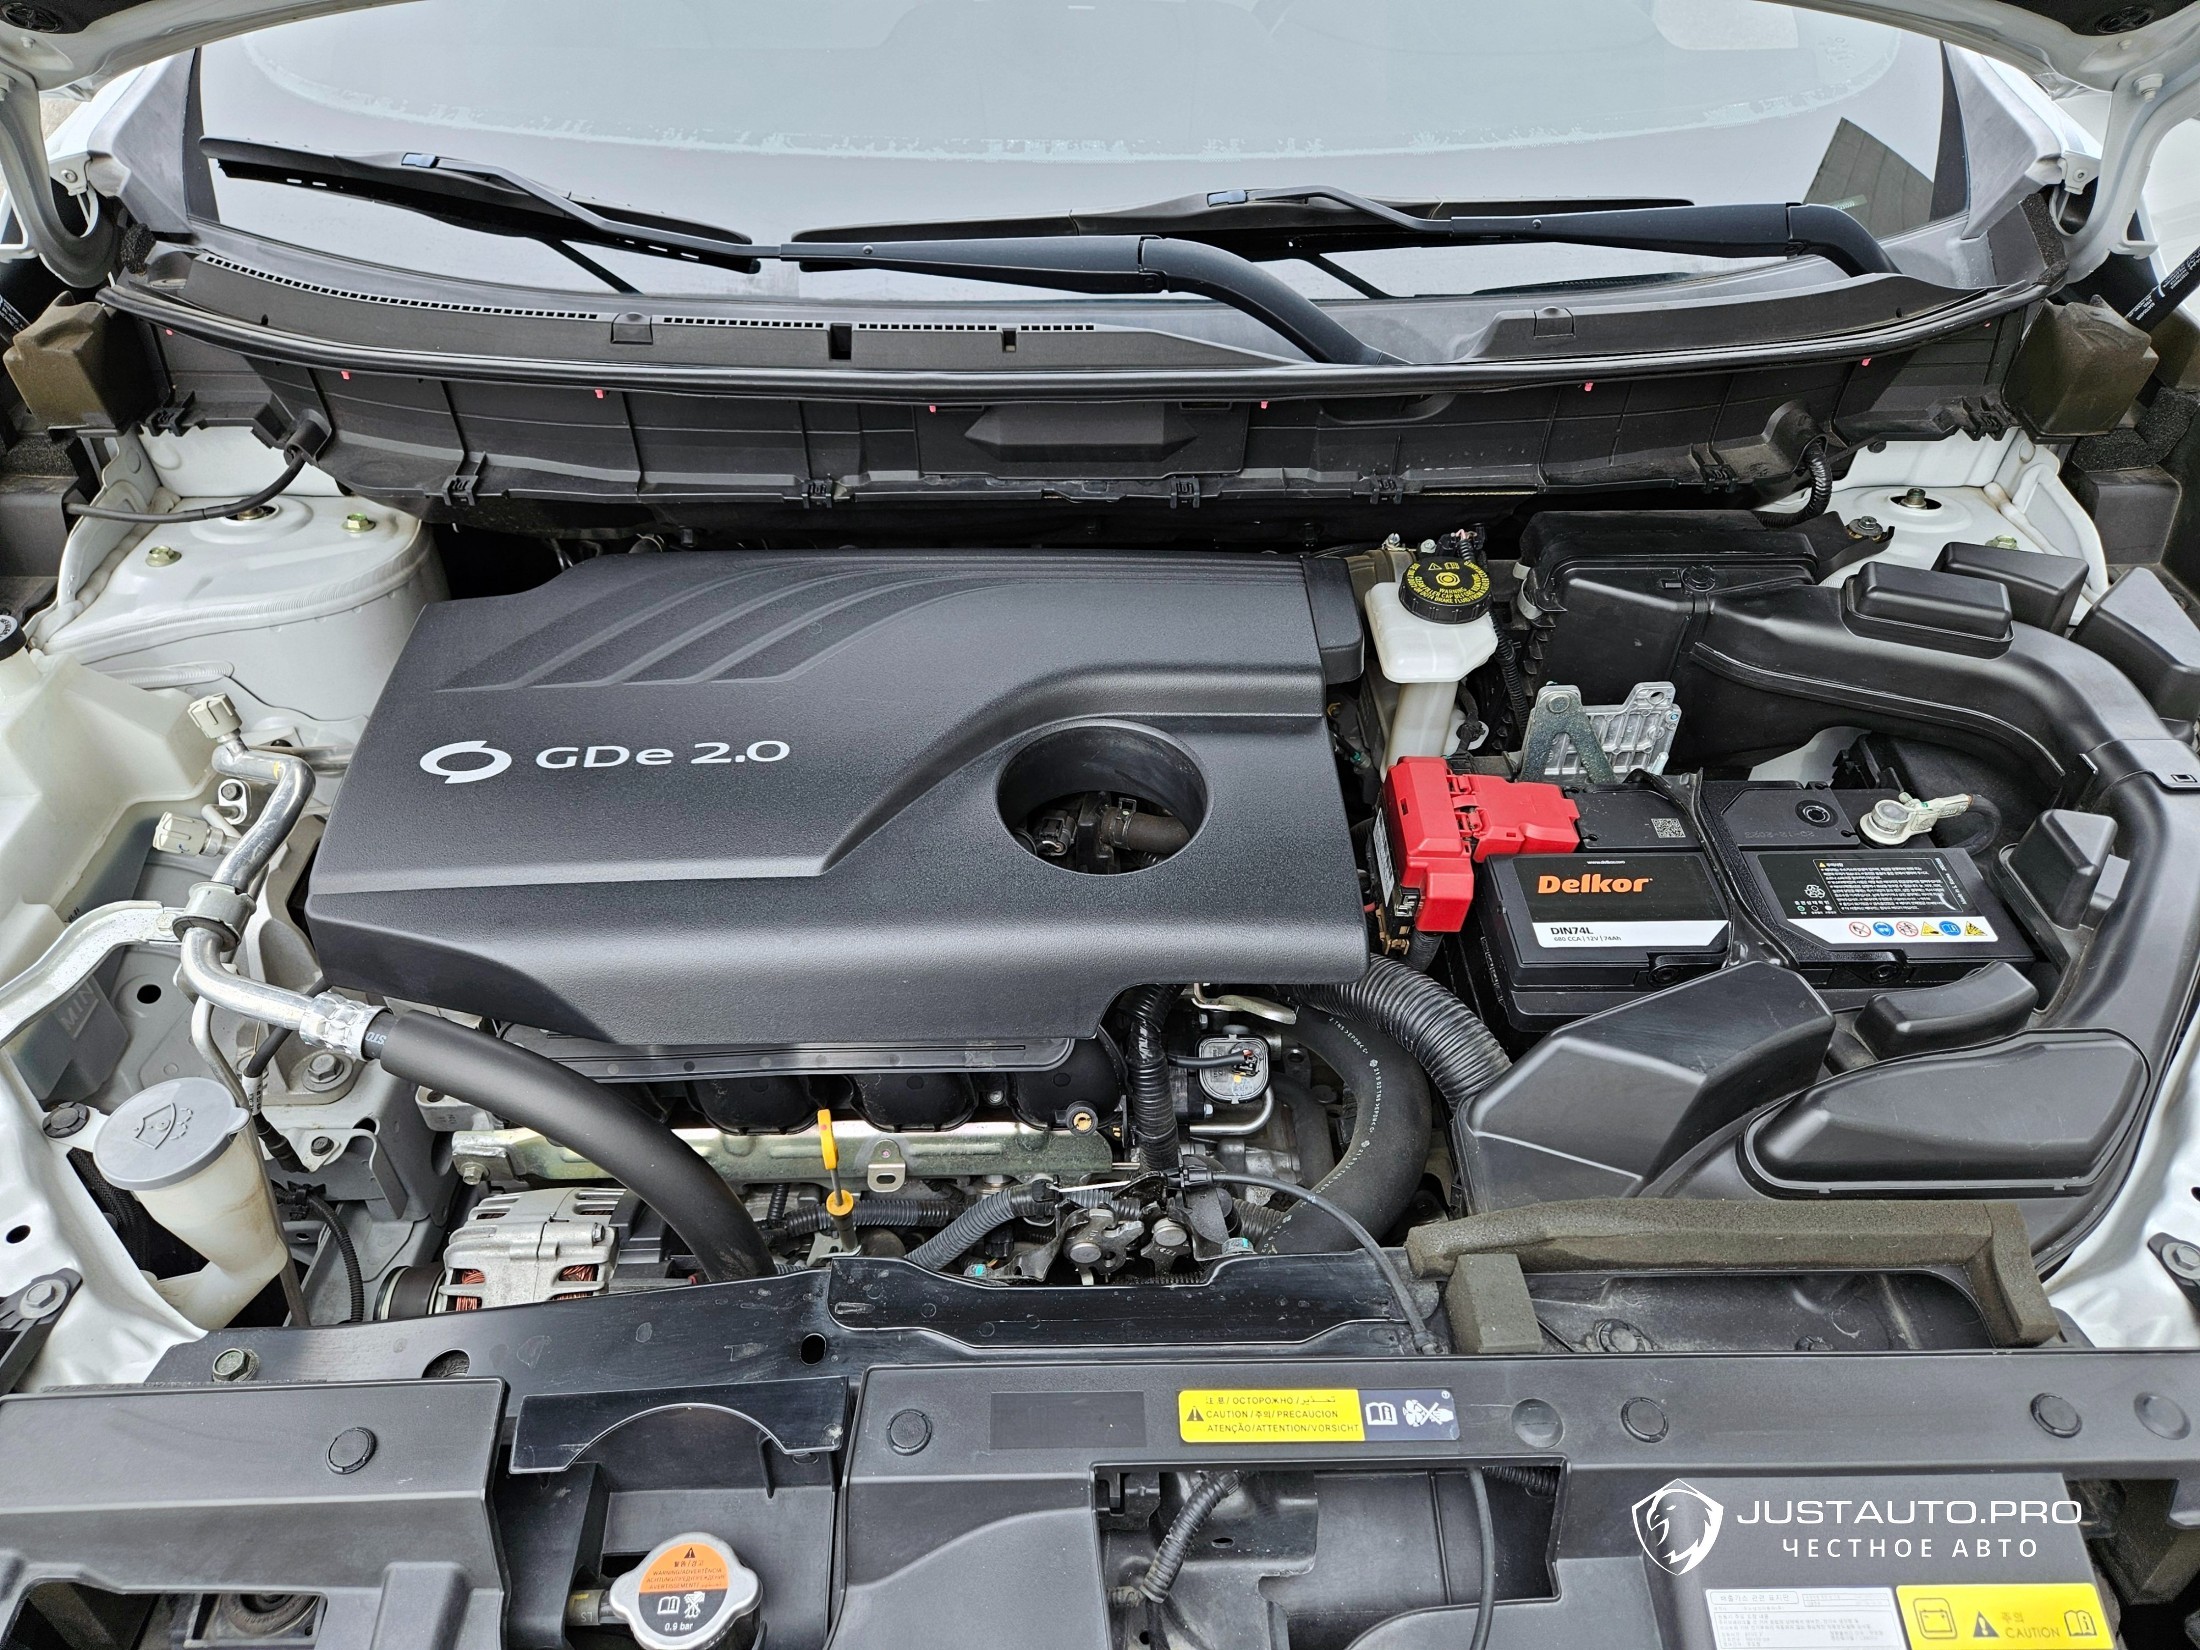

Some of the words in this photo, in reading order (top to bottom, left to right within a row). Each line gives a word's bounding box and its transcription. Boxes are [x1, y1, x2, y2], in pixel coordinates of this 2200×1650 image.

[535, 746, 675, 770] GDe
[691, 740, 790, 764] 2.0
[1537, 873, 1649, 894] Delkor
[1550, 926, 1594, 935] DIN74L
[61, 981, 95, 1030] MIN
[1232, 1396, 1293, 1405] ОСТОРОЖНО
[1206, 1410, 1248, 1419] CAUTION
[2000, 1611, 2025, 1624] 주의
[664, 1622, 678, 1632] 0.9
[679, 1621, 694, 1631] bar
[2004, 1626, 2062, 1640] CAUTION
